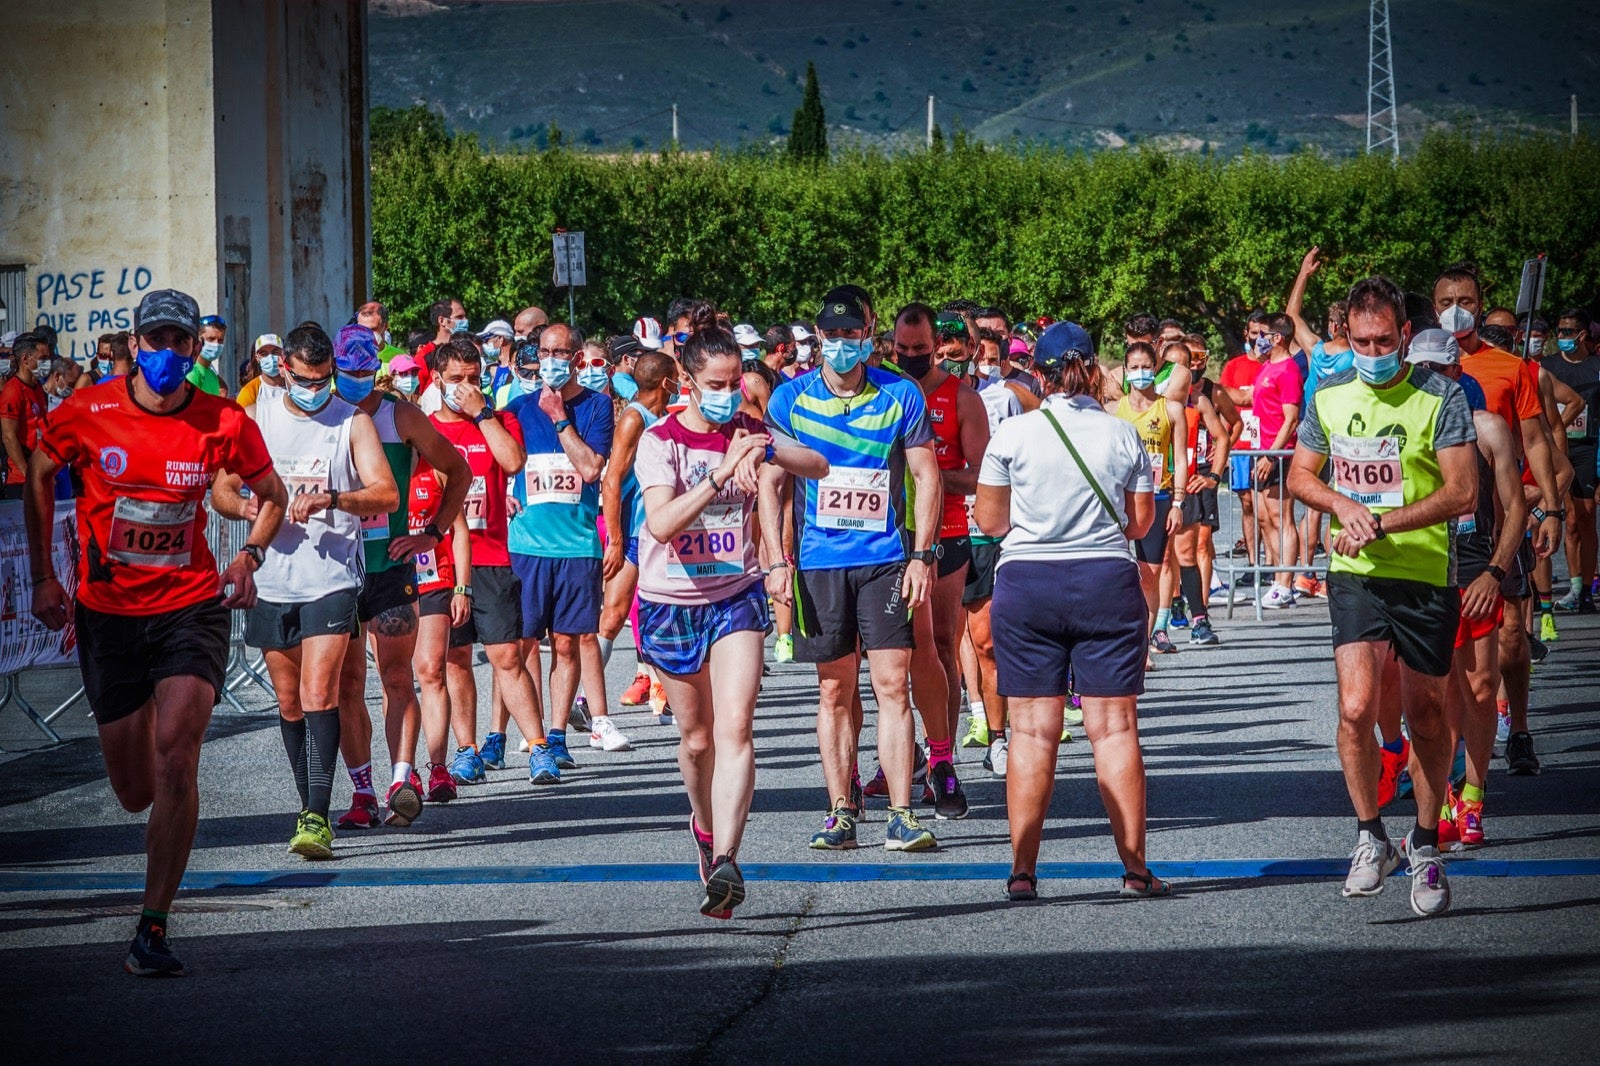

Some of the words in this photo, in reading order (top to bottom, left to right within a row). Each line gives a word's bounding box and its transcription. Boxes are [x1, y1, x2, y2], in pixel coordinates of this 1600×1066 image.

[36, 270, 105, 309] PASE
[117, 266, 152, 294] LO
[36, 312, 78, 333] QUE
[88, 307, 137, 331] PAS
[70, 339, 96, 360] LU
[532, 475, 576, 491] 1023
[1342, 461, 1394, 485] 2160
[463, 499, 482, 516] 77
[828, 490, 881, 512] 2179
[1361, 492, 1382, 504] MARÍA
[409, 515, 432, 527] lud
[837, 518, 865, 528] EDUARDO
[123, 528, 186, 552] 1024
[678, 531, 736, 555] 2180
[696, 565, 717, 575] MAITE
